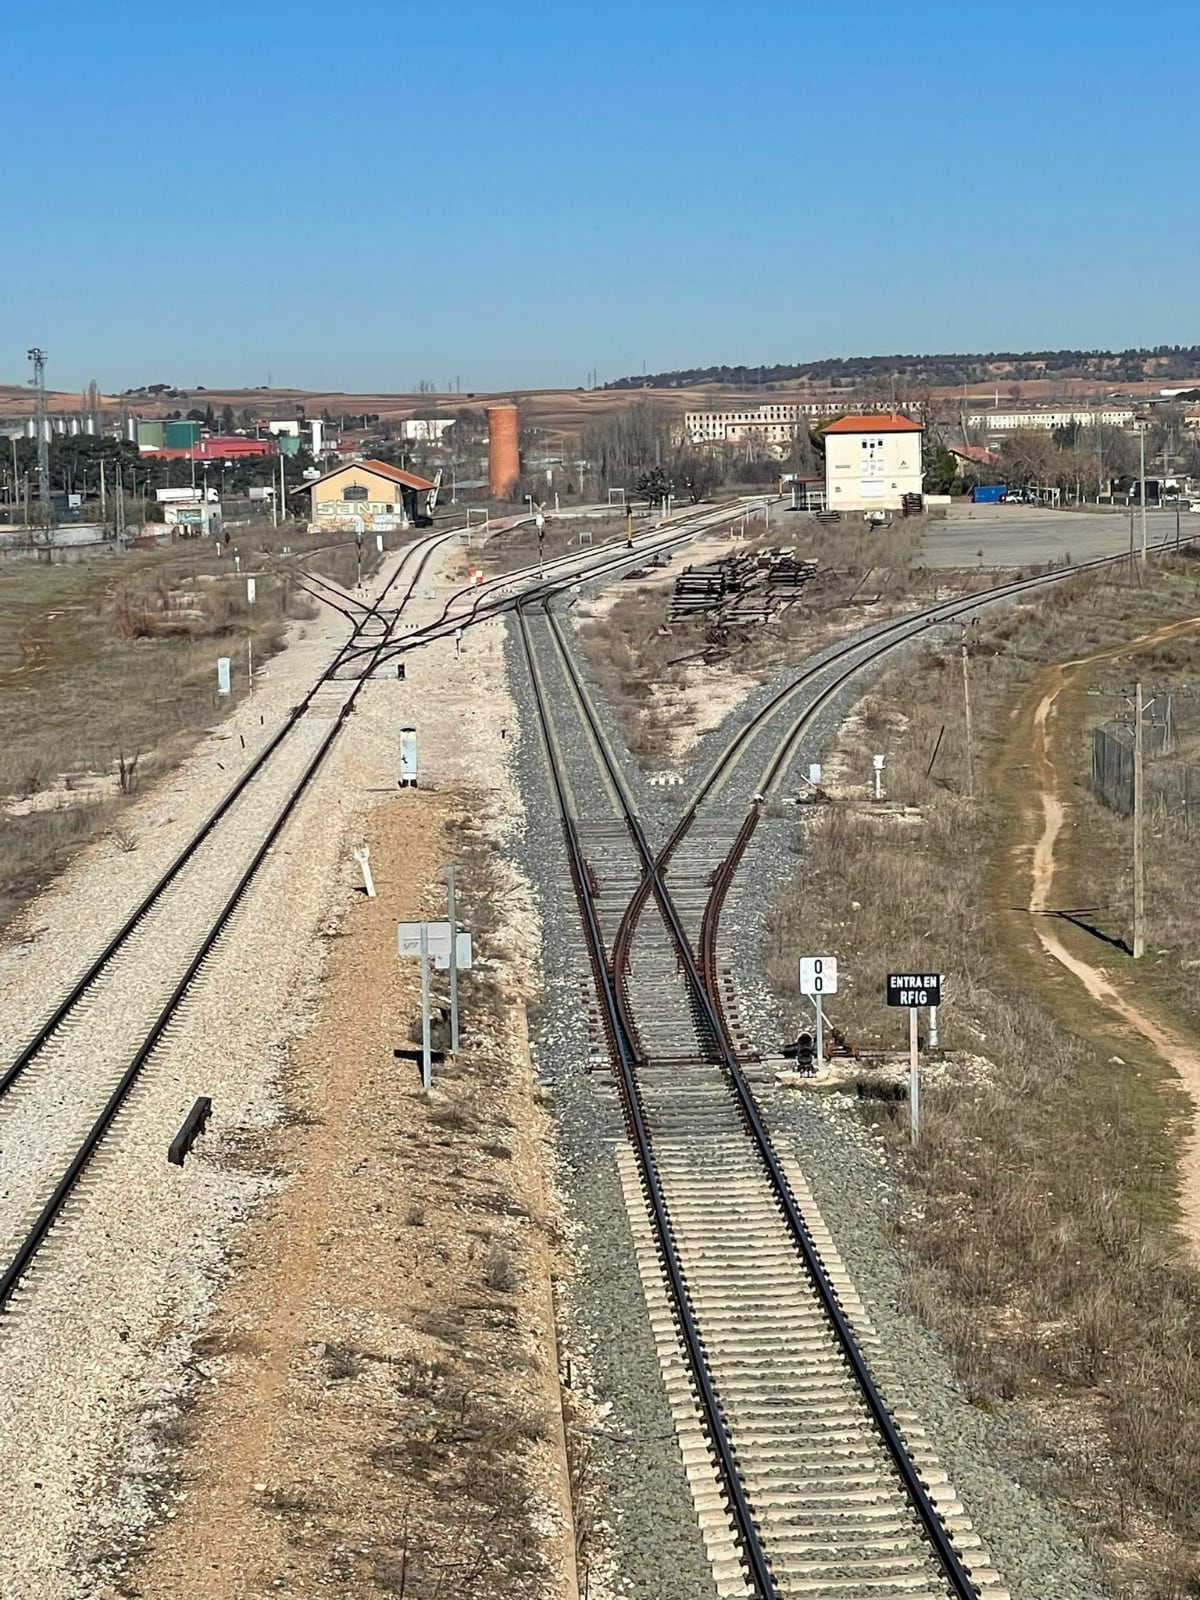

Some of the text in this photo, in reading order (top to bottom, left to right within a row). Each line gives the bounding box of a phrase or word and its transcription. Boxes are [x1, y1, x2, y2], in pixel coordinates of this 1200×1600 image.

[890, 976, 937, 988] ENTRA EN
[900, 991, 927, 1005] RFIG
